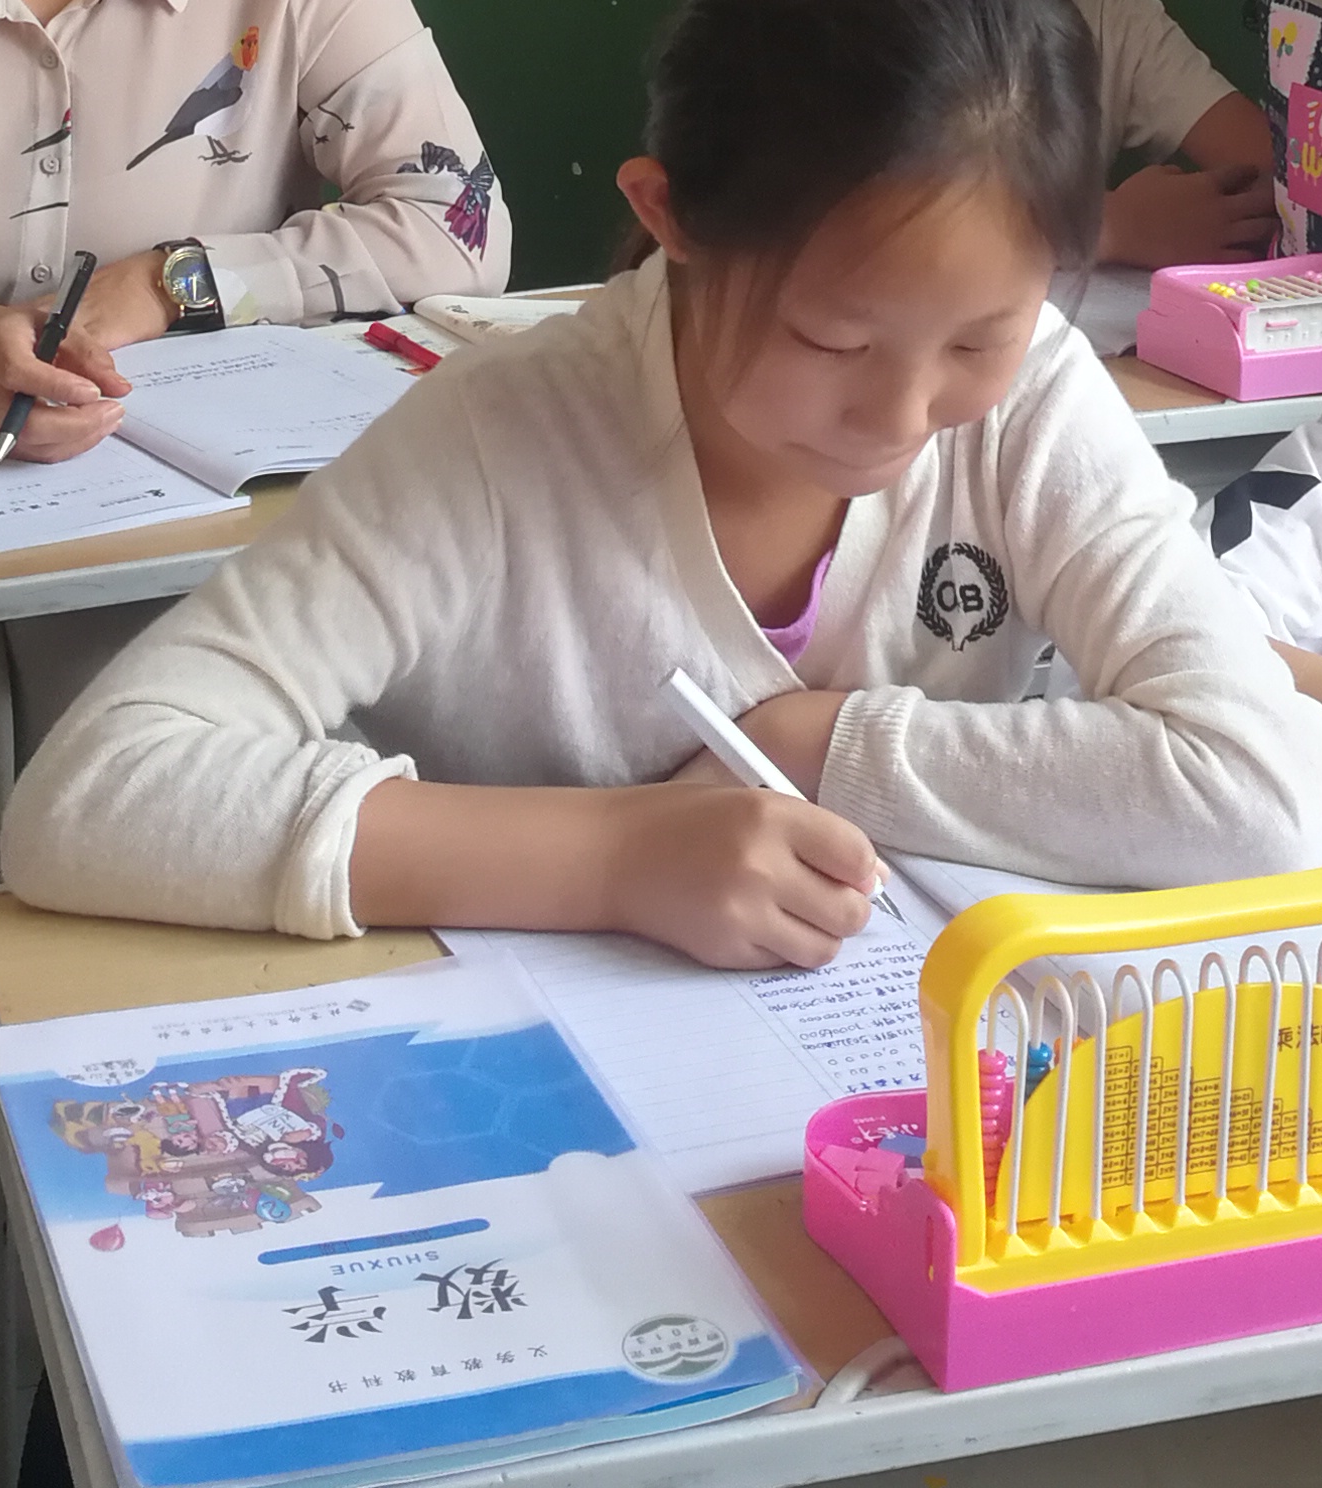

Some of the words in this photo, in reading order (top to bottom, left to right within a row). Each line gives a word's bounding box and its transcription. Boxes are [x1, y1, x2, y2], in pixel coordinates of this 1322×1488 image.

[330, 1250, 440, 1276] SHUXUE
[281, 1258, 529, 1343] 数学
[328, 1344, 548, 1394] 义务教育教科书
